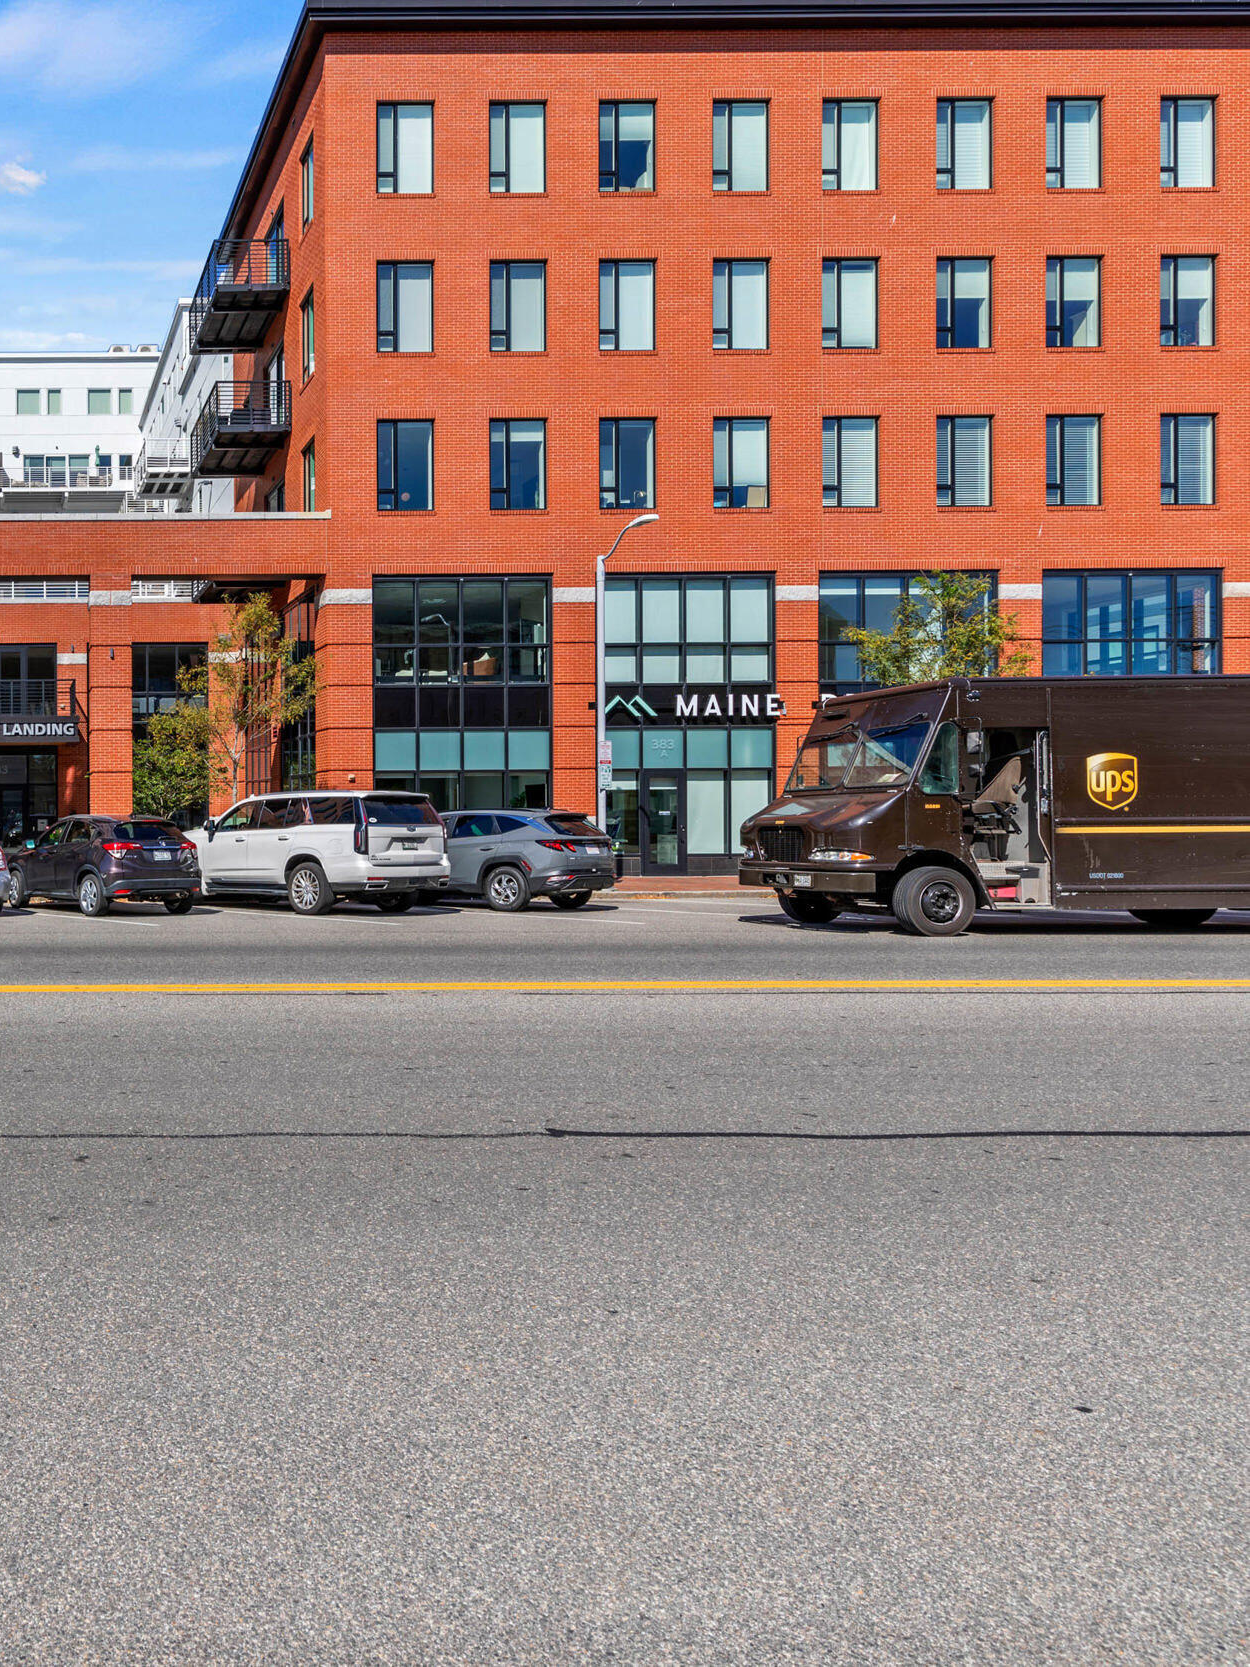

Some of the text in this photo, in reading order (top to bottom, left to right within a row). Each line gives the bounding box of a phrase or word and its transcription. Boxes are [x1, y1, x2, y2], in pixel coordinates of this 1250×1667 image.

[676, 694, 782, 717] MAINE
[3, 723, 75, 736] LANDING
[652, 738, 675, 749] 383
[1091, 770, 1134, 801] ups
